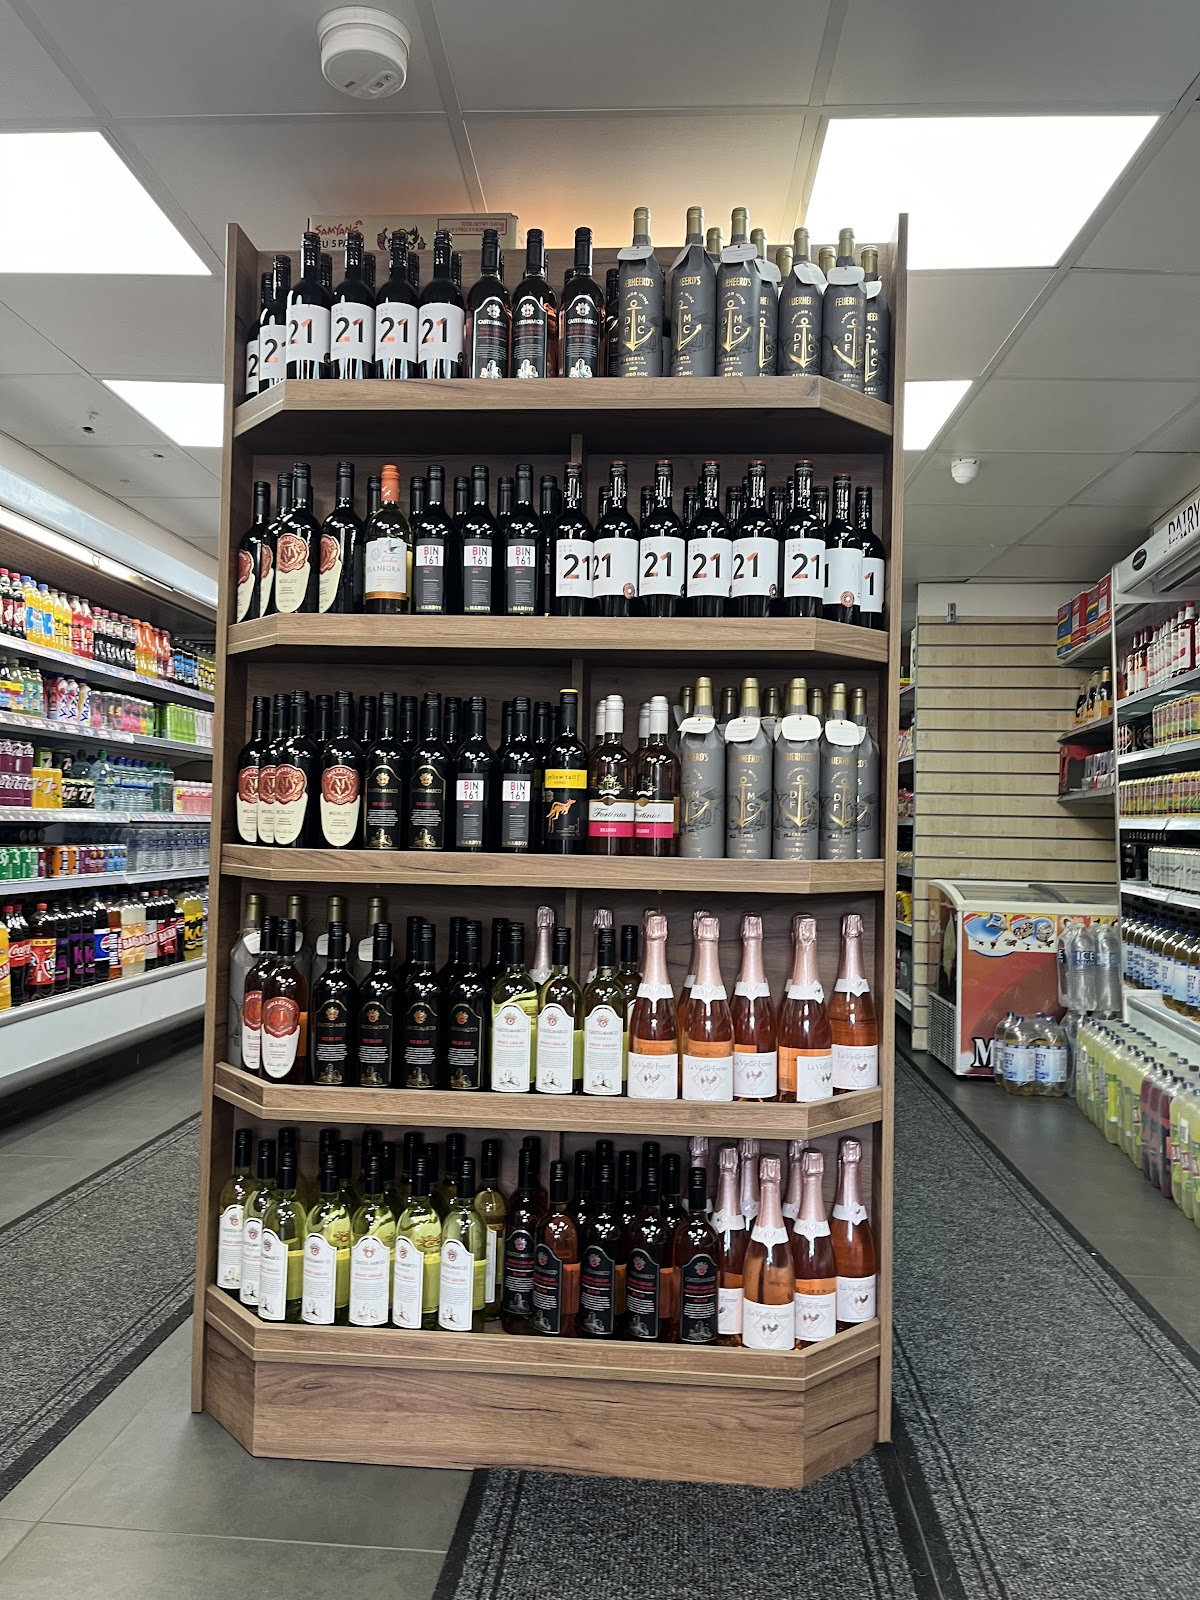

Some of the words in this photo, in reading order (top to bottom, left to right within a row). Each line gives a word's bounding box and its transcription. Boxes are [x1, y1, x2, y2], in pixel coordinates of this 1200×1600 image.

[315, 223, 360, 236] SAMYANG
[637, 314, 646, 324] M
[683, 313, 692, 323] M
[734, 314, 742, 324] M
[287, 318, 313, 345] 21
[335, 317, 364, 344] 21
[379, 317, 409, 344] 21
[420, 318, 449, 345] 21
[637, 325, 645, 335] C
[683, 324, 691, 334] C
[733, 325, 741, 335] C
[793, 333, 801, 342] D
[844, 333, 852, 342] D
[264, 338, 287, 364] 2
[793, 343, 800, 352] F
[844, 343, 851, 352] F
[247, 353, 259, 379] 2
[1168, 498, 1200, 546] DAIRY
[423, 546, 439, 556] BIN
[472, 546, 488, 556] BIN
[515, 546, 531, 556] BIN
[424, 556, 439, 565] 161
[473, 556, 488, 566] 161
[515, 556, 531, 566] 161
[643, 551, 672, 578] 21
[563, 553, 591, 581] 21
[592, 553, 611, 581] 21
[692, 553, 720, 579] 21
[733, 552, 758, 581] 21
[791, 554, 820, 580] 21
[863, 571, 875, 596] 1
[463, 781, 479, 791] BIN
[510, 781, 526, 791] BIN
[463, 791, 479, 800] 161
[510, 791, 526, 801] 161
[747, 791, 756, 801] M
[789, 790, 798, 799] D
[833, 793, 841, 802] D
[747, 802, 755, 812] C
[789, 801, 796, 810] F
[833, 803, 840, 812] F
[592, 806, 628, 819] Fortinia
[1076, 951, 1096, 961] ICE
